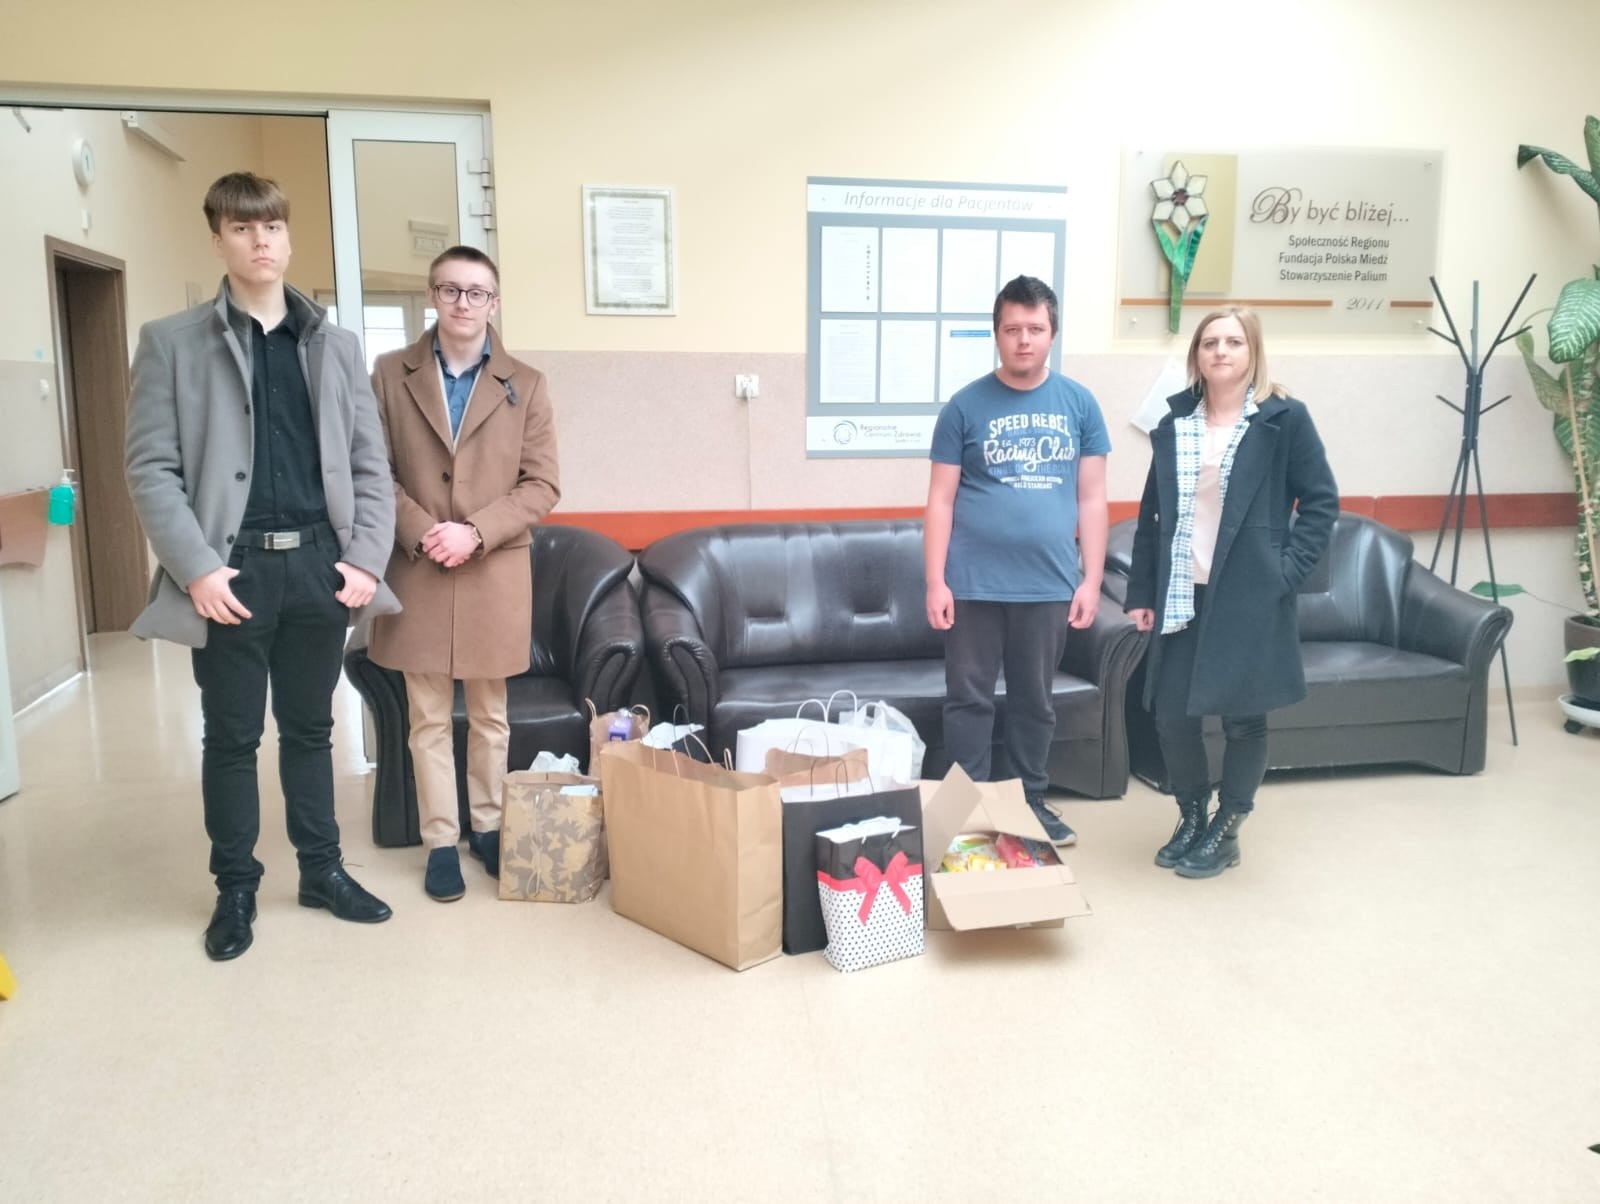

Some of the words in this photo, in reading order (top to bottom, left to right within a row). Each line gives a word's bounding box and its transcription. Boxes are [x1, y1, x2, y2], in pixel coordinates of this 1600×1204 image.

[843, 191, 926, 211] Informacje
[931, 194, 953, 209] dla
[958, 196, 1034, 212] Pacjentów
[1249, 186, 1303, 224] By
[1307, 200, 1340, 225] być
[1345, 200, 1409, 226] bliżej...
[1288, 234, 1349, 249] Społeczność
[1351, 236, 1389, 250] Regionu
[1278, 252, 1323, 266] Fundacja
[1325, 253, 1357, 265] Polska
[1279, 269, 1352, 283] Stowarzyszenie
[1354, 270, 1388, 282] Palium
[989, 413, 1029, 439] SPEED
[1031, 413, 1071, 438] REBEL
[1018, 437, 1036, 447] 1973
[983, 439, 1038, 472] Racing
[1037, 436, 1076, 462] Club
